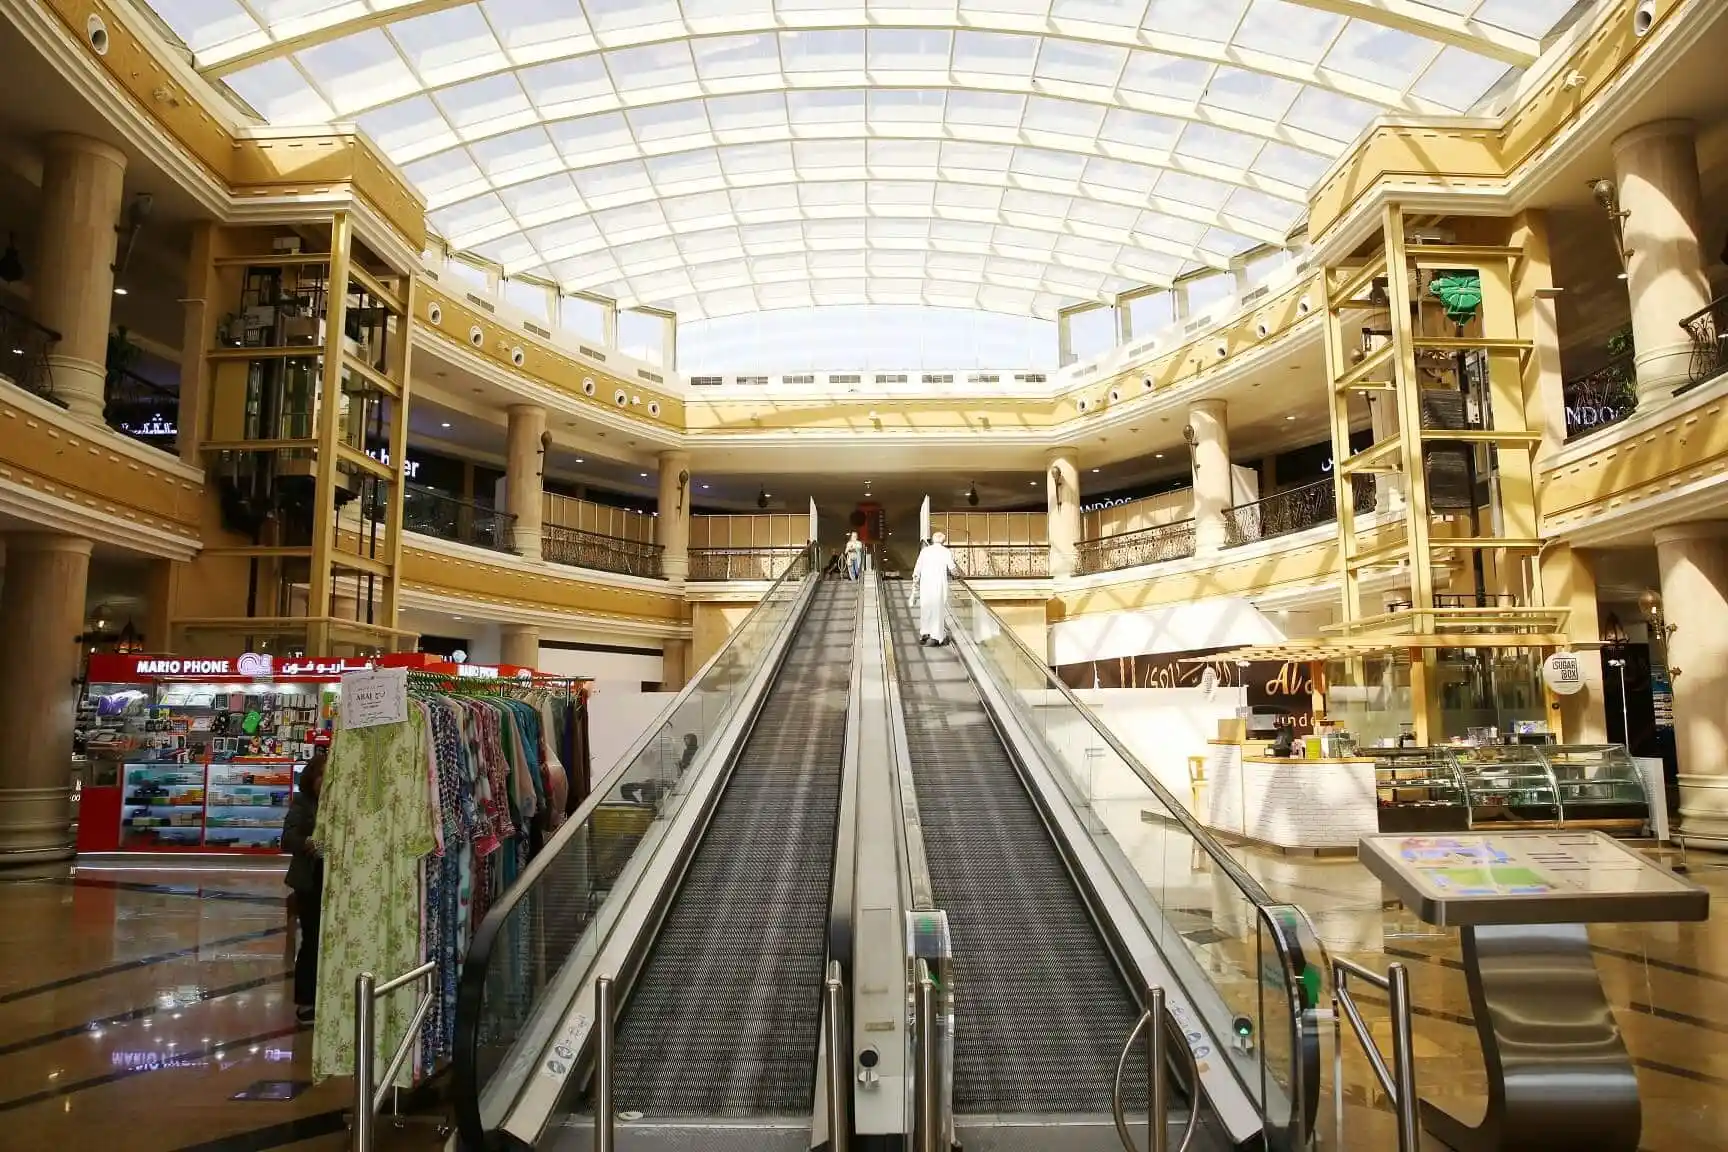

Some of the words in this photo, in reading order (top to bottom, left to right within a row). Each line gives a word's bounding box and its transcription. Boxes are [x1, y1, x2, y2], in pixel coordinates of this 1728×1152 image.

[136, 660, 181, 674] MARIO
[183, 660, 229, 674] PHONE
[282, 660, 315, 675] فون
[1552, 660, 1576, 670] SUGAR
[1561, 669, 1578, 680] BOX
